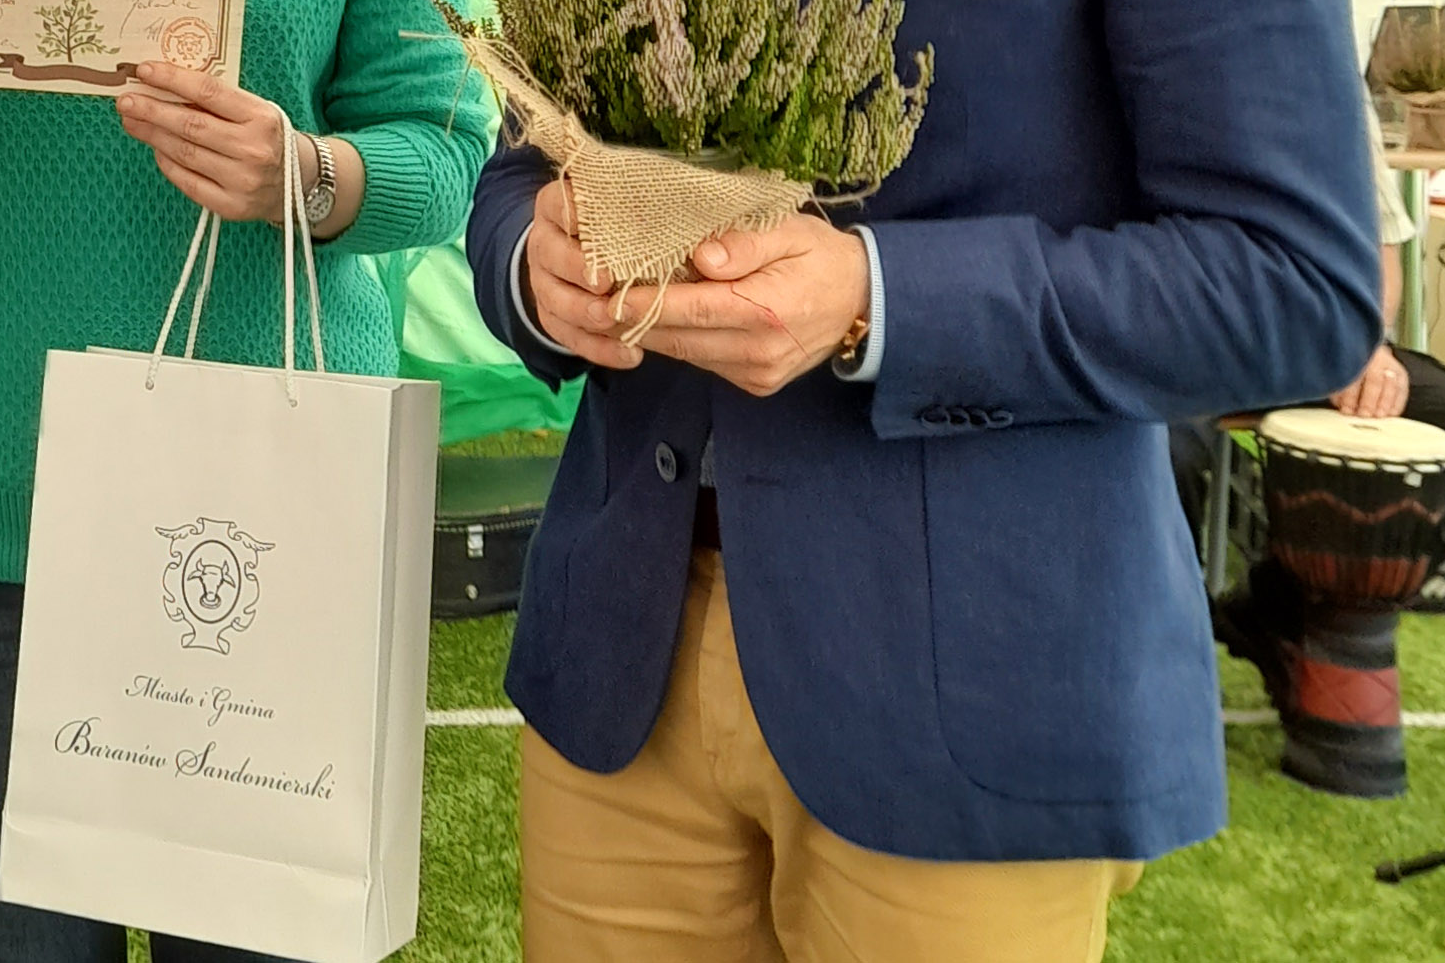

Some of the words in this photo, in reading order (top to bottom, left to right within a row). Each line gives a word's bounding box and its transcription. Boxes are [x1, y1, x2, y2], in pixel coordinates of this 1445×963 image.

[125, 675, 194, 707] Miasto
[199, 692, 208, 708] i
[207, 686, 275, 727] Gmina
[55, 717, 168, 768] Baranów
[175, 741, 335, 801] Sandomierski
